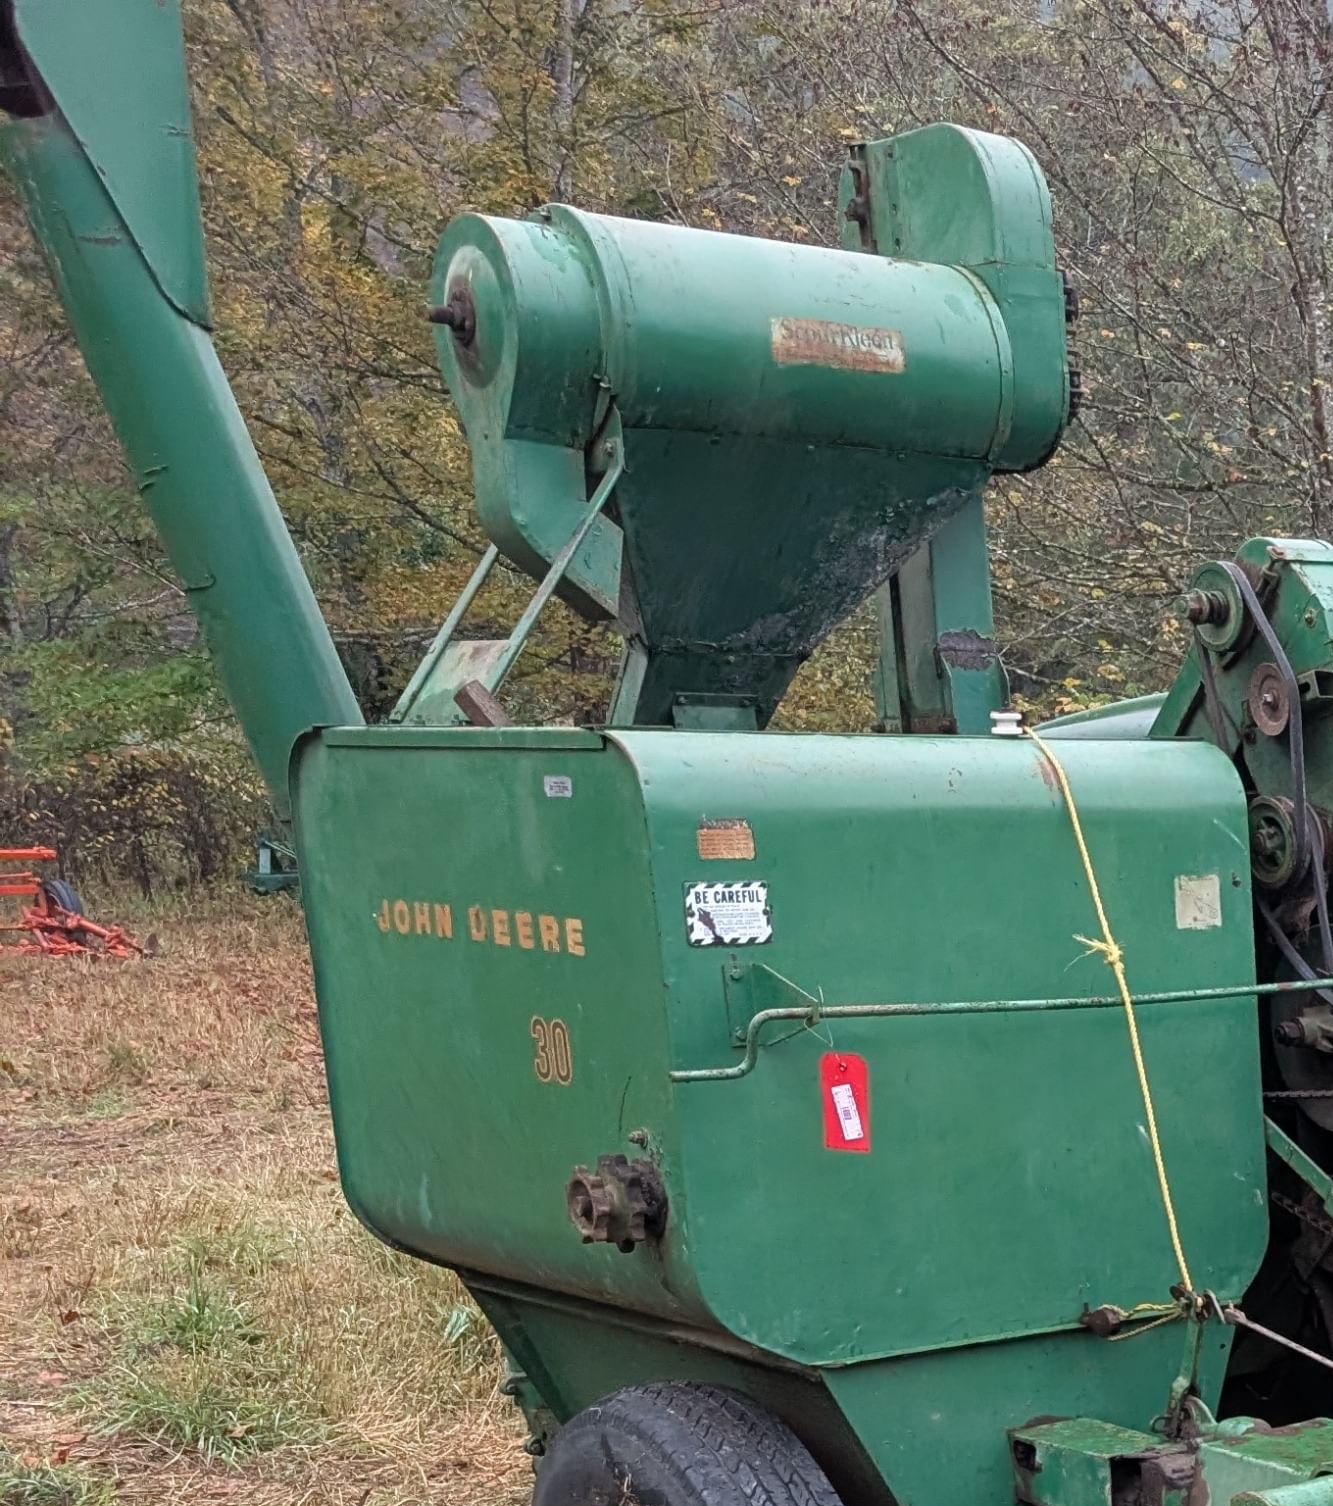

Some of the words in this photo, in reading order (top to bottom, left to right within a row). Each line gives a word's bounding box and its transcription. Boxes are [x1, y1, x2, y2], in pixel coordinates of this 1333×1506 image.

[694, 891, 710, 905] BE
[713, 889, 763, 904] CAREFUL
[378, 899, 453, 938] JOHN
[467, 905, 586, 956] DEERE
[531, 1014, 573, 1086] 30
